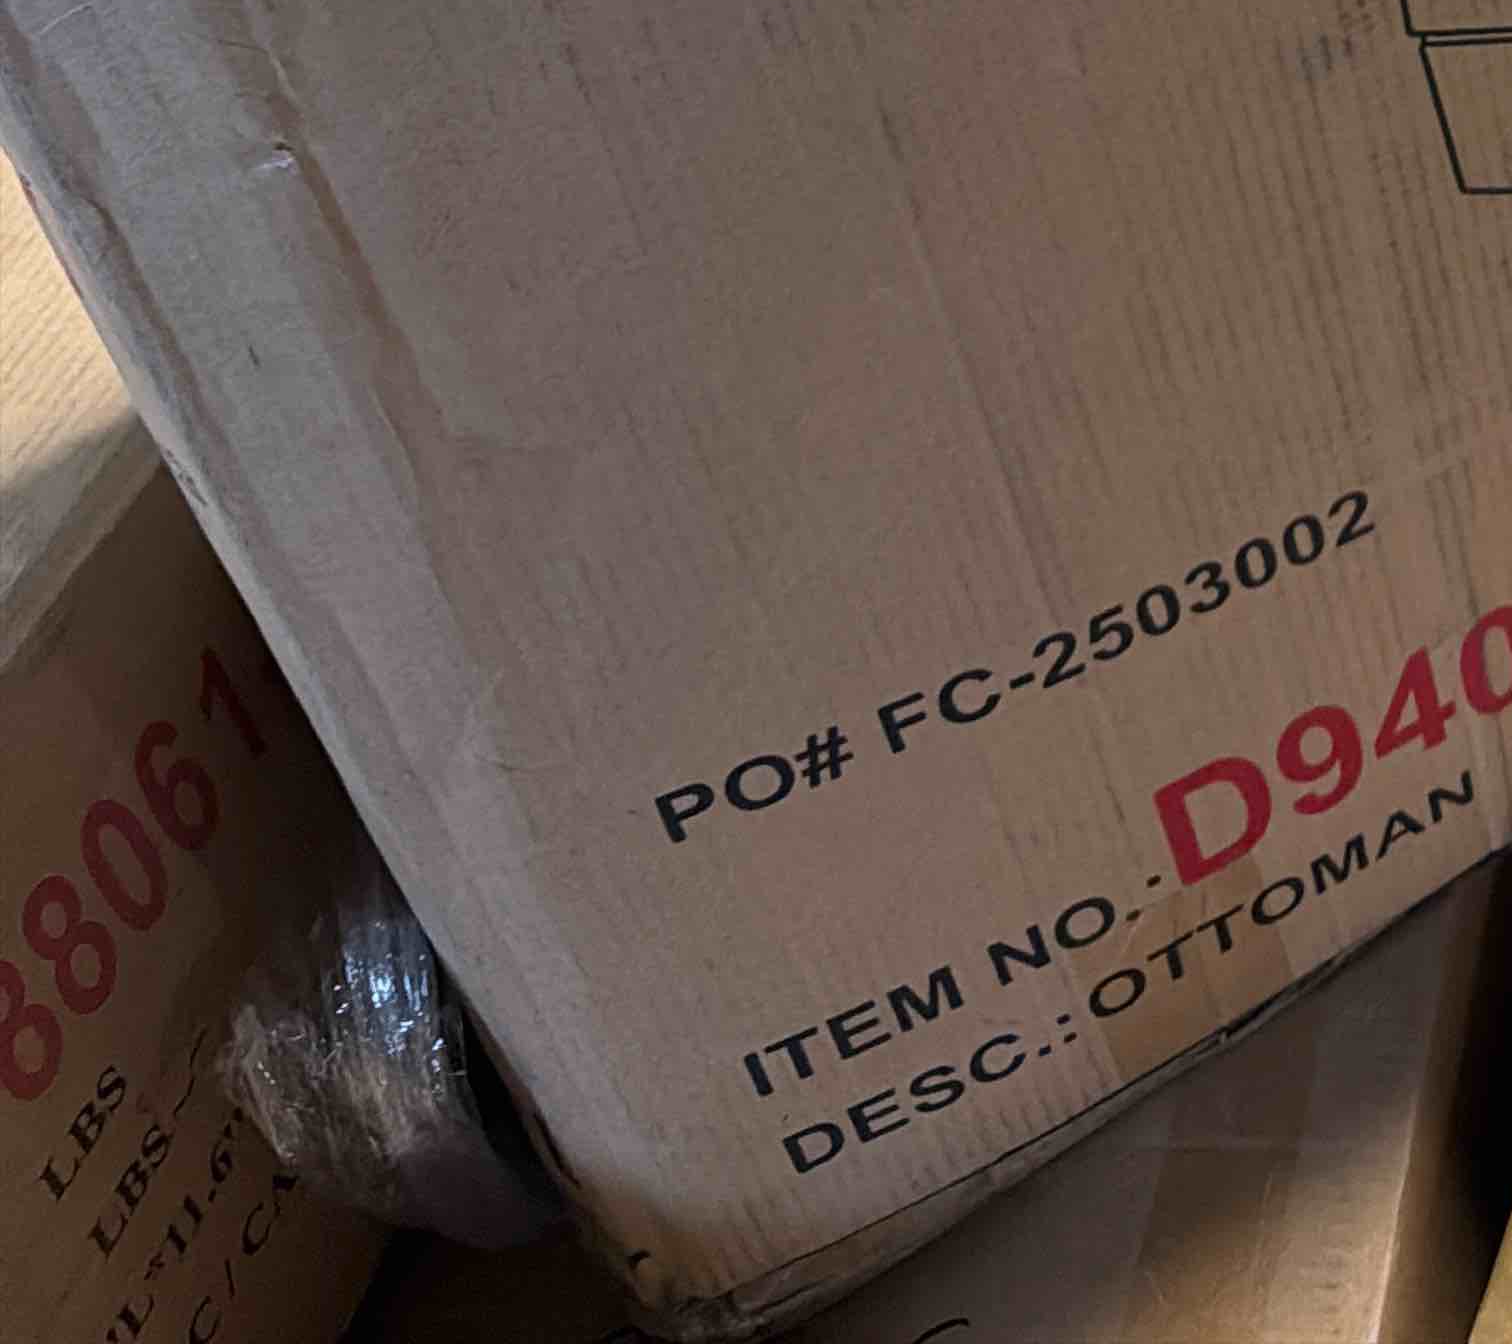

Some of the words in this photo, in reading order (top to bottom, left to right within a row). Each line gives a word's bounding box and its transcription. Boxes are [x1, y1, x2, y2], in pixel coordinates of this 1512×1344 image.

[654, 725, 854, 844] PO#
[877, 489, 1375, 755] FC-2503002
[743, 965, 965, 1098] ITEM
[37, 1065, 127, 1204] LBS
[88, 1122, 174, 1261] LBS
